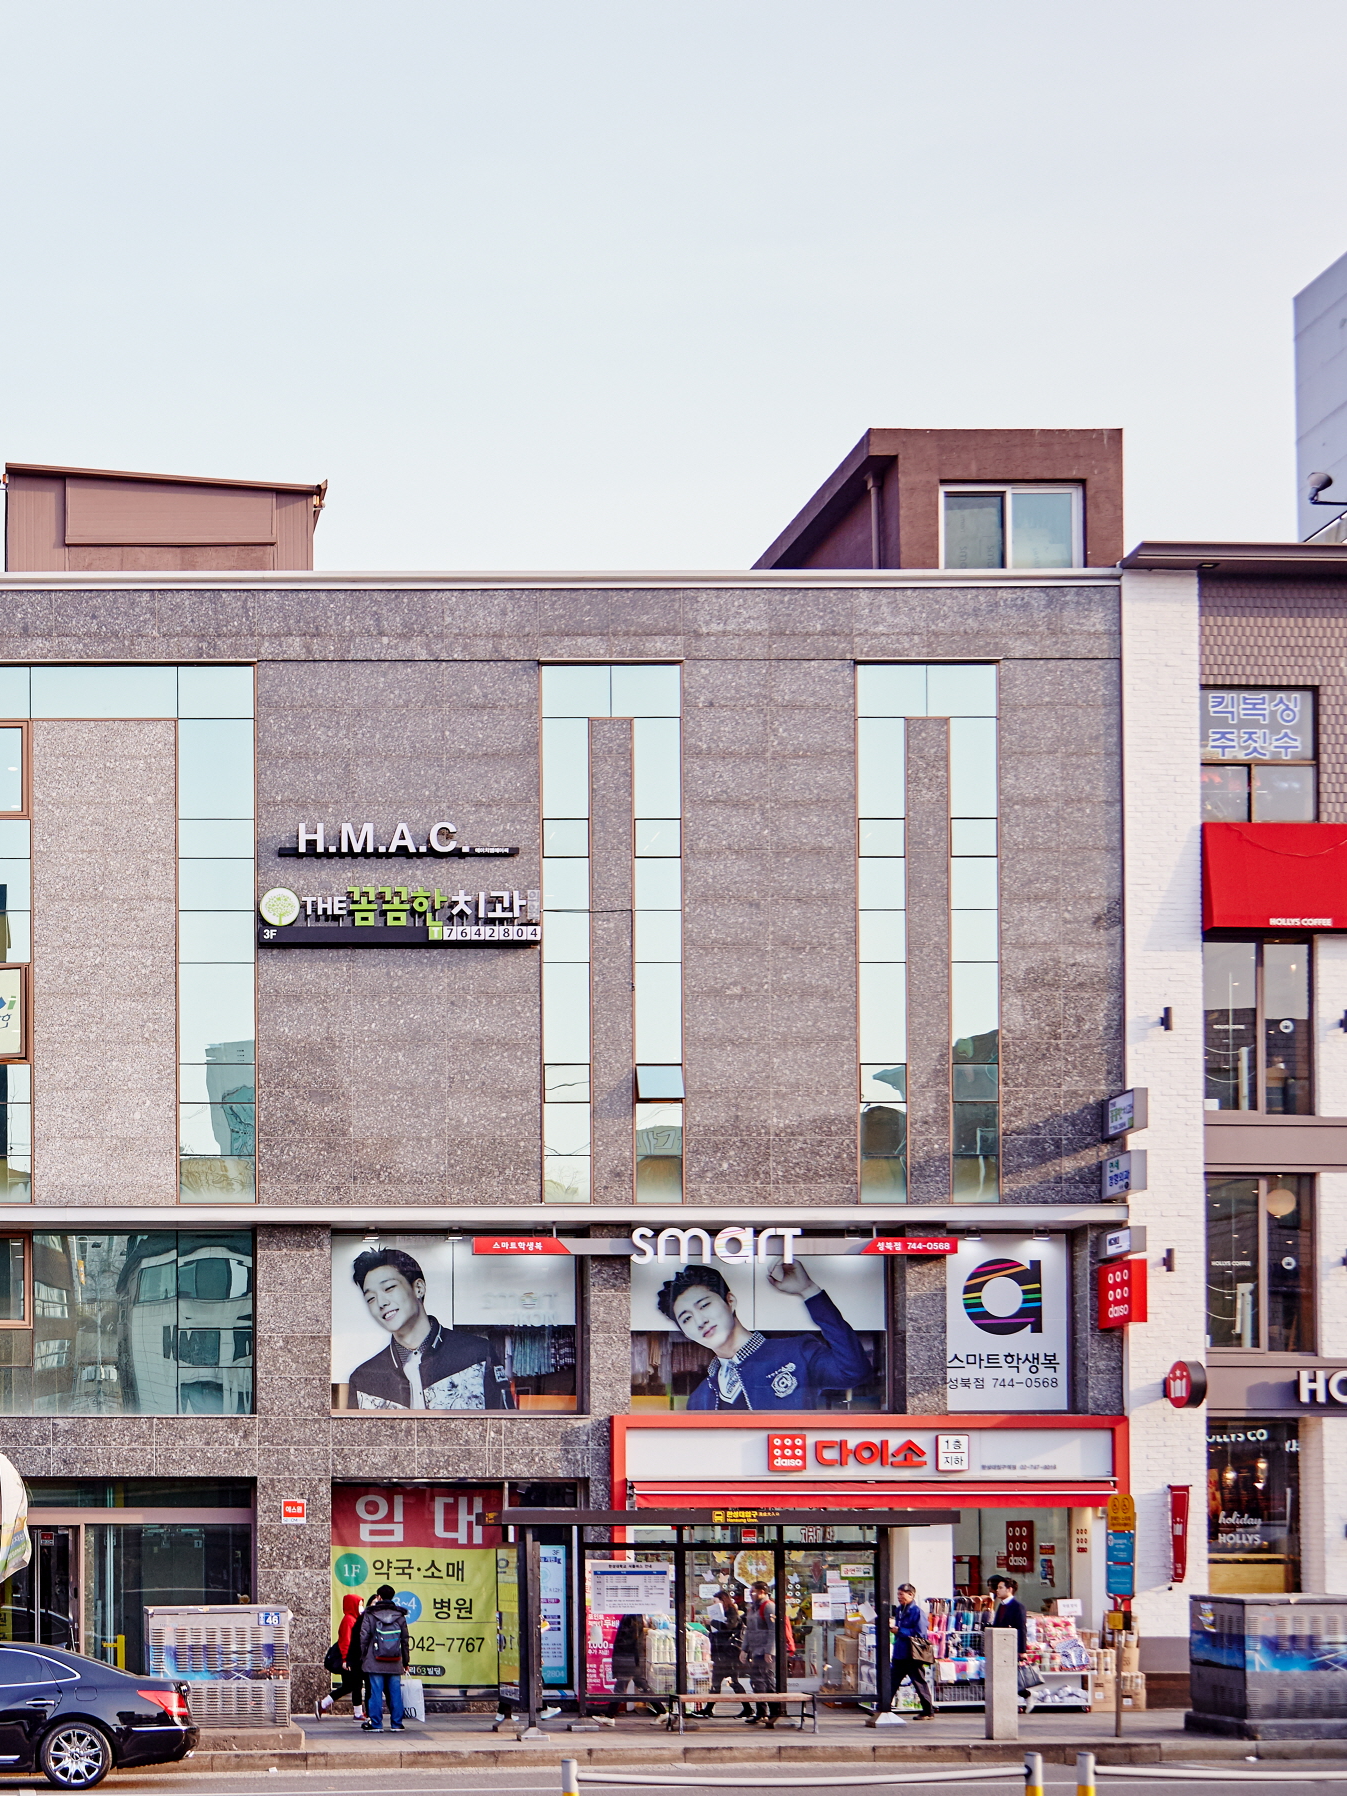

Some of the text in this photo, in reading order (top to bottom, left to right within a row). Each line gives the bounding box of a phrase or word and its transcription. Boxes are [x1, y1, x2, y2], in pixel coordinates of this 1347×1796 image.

[1209, 694, 1301, 724] 킥복싱
[1209, 729, 1302, 759] 주짓수
[298, 822, 470, 853] H.M.A.C.
[302, 896, 347, 916] THE
[1269, 918, 1332, 926] HOLLYS COFFEE
[263, 929, 277, 939] 3F
[492, 1241, 543, 1251] 스마트학생복
[630, 1226, 802, 1265] smart
[876, 1241, 951, 1251] 성북점 744-0568
[1108, 1304, 1129, 1318] daiso
[947, 1353, 1060, 1374] 스마트학생복
[947, 1377, 1059, 1389] 성북점 744-0568
[944, 1439, 962, 1450] 1층
[815, 1439, 927, 1466] 다이소
[774, 1456, 802, 1467] daiso
[944, 1455, 964, 1466] 지하
[1218, 1511, 1262, 1531] holiday
[1218, 1533, 1262, 1544] HOLLYS
[1008, 1554, 1028, 1566] daiso
[343, 1564, 360, 1577] 1F
[433, 1597, 473, 1620] 병원
[265, 1615, 279, 1625] 46
